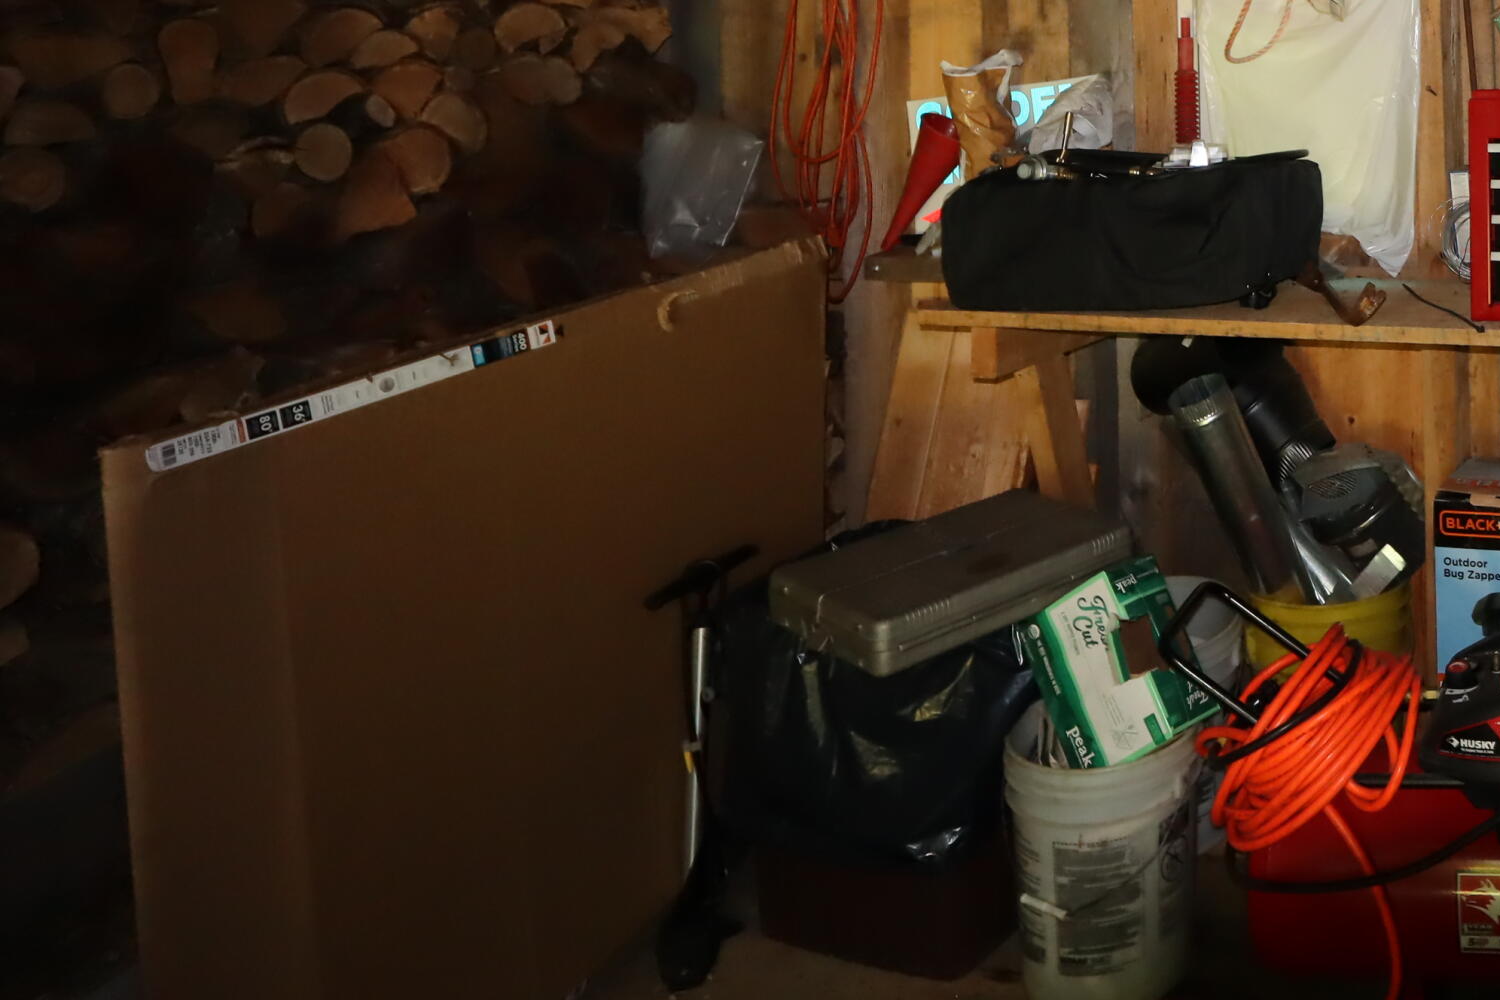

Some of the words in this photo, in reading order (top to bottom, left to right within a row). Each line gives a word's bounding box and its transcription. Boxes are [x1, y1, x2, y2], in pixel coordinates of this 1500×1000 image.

[1443, 557, 1488, 568] Outdoor
[1443, 568, 1464, 580] Bug
[1072, 616, 1099, 649] Cut
[1065, 724, 1097, 770] peak
[1460, 739, 1496, 750] HUSKY
